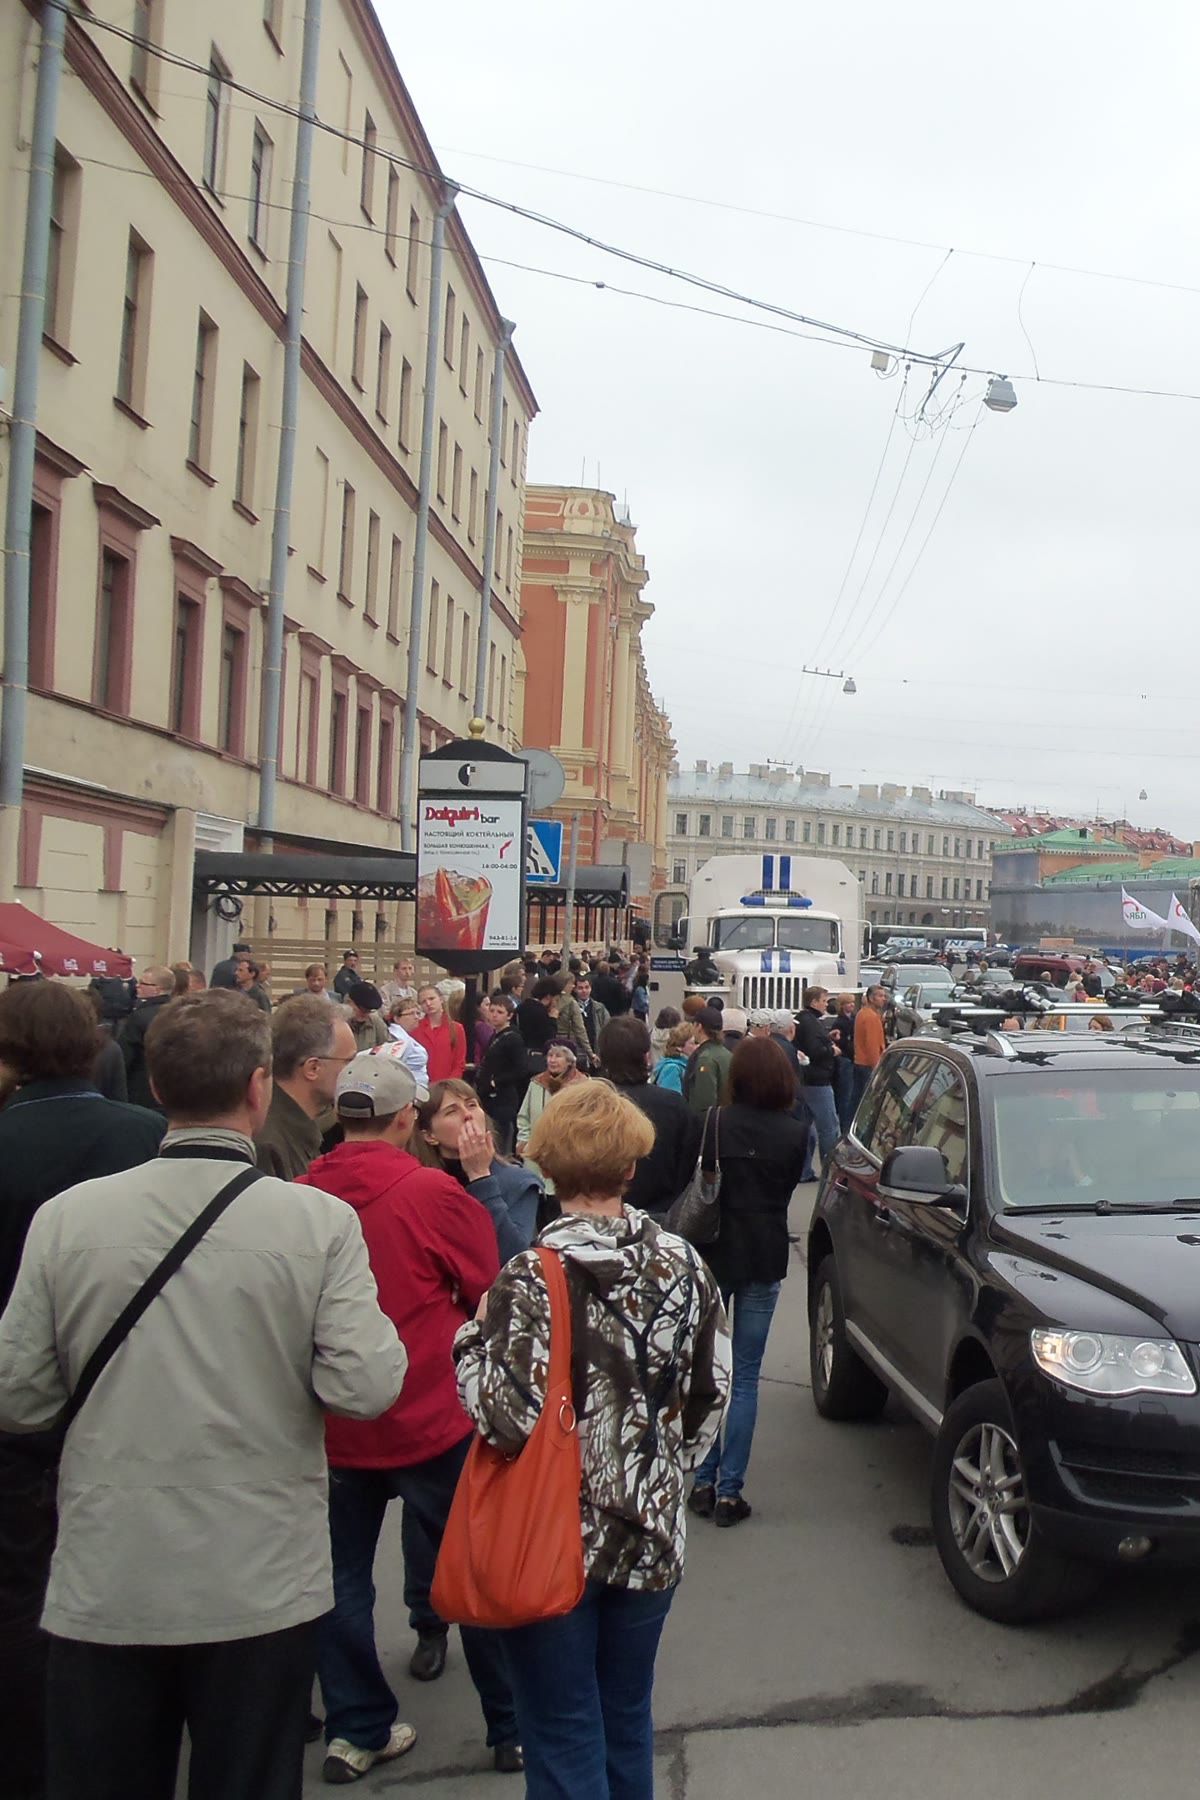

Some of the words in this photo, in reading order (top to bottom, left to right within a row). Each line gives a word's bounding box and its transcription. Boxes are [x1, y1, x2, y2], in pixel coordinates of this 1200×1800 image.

[425, 806, 480, 827] Daiquiri
[480, 814, 500, 824] bar
[424, 830, 465, 838] НАСТОЯЩИЙ
[466, 830, 515, 838] КОКТЕЙЛЬНЫЙ
